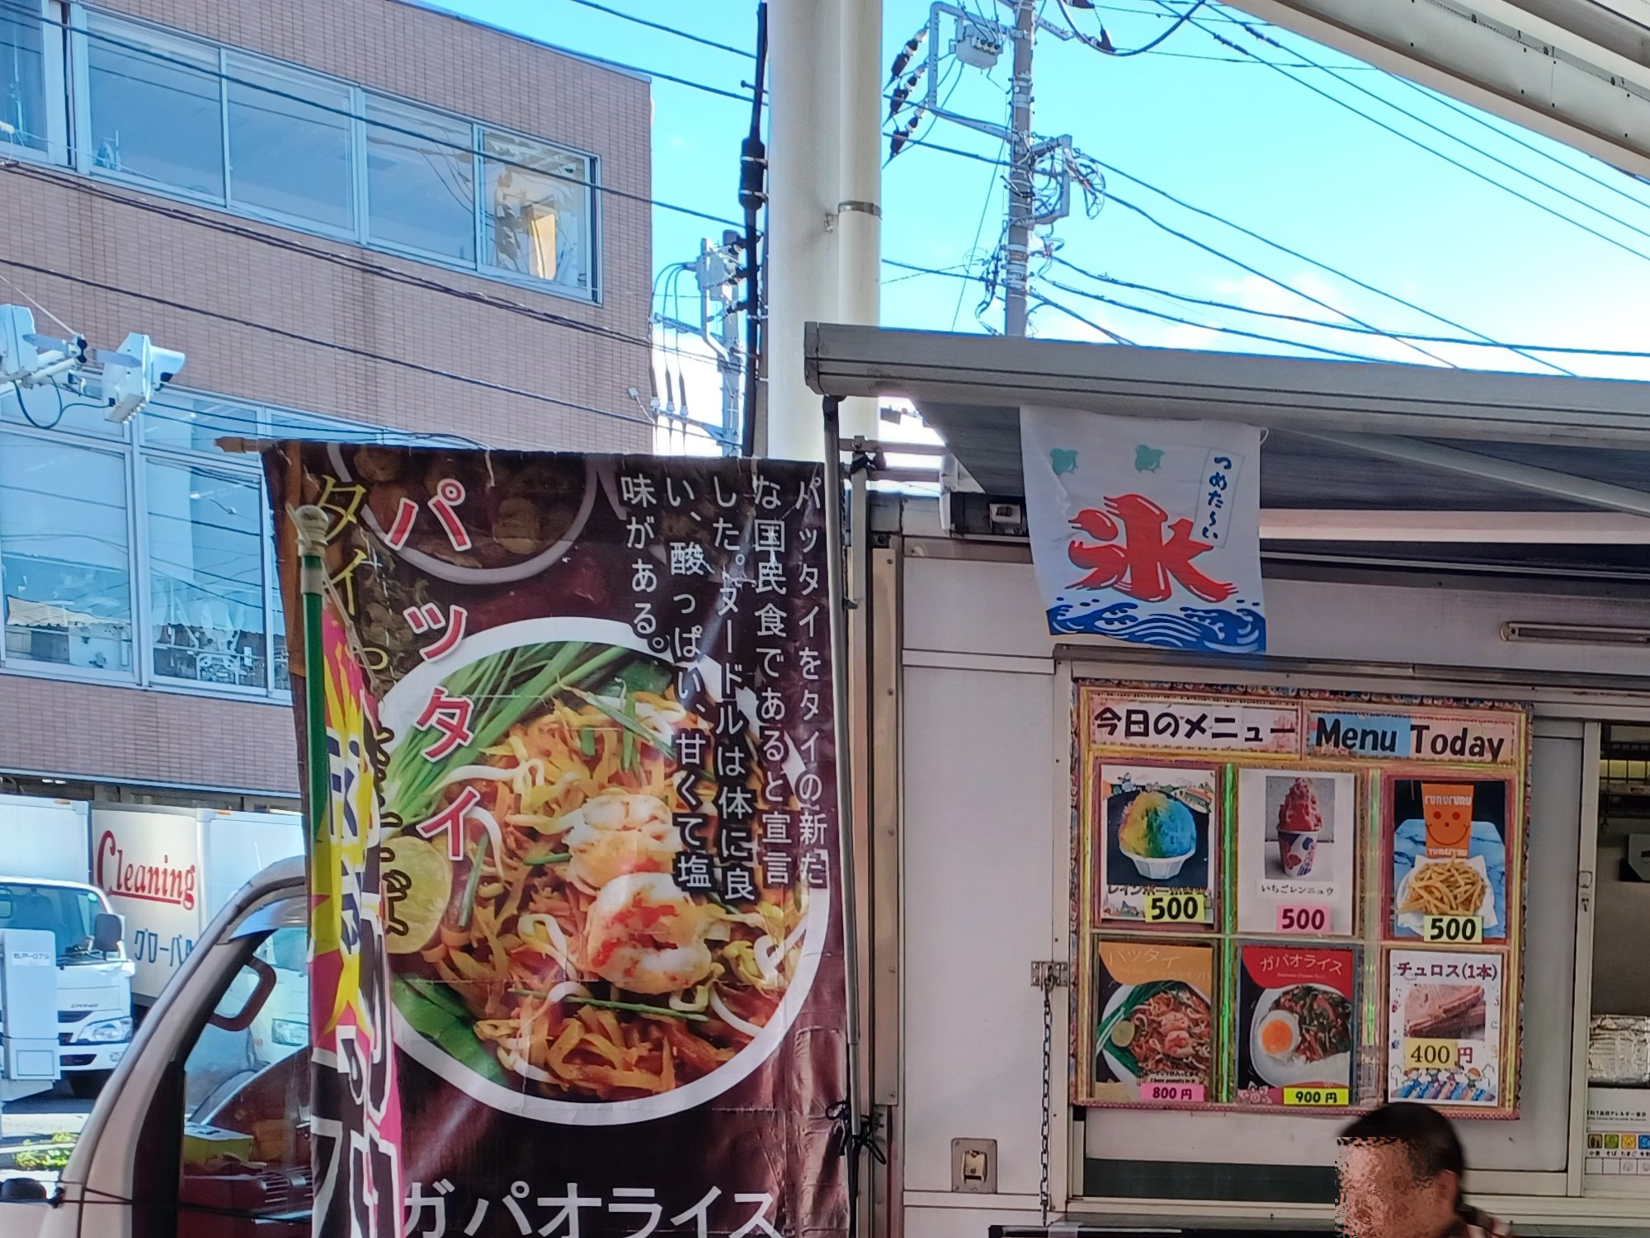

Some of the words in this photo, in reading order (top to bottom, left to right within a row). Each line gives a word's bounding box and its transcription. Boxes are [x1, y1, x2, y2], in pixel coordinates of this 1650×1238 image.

[621, 475, 665, 653] 味がある。
[1064, 493, 1239, 603] 氷
[385, 477, 479, 861] パッタイ
[666, 477, 712, 889] い、酸っぱい、甘くて塩
[712, 476, 755, 901] した。ヌードルは体に良
[754, 477, 791, 885] な国民食であると宣言
[796, 476, 828, 885] パッタイをタイの新た
[1094, 706, 1296, 744] 今日のメニュー
[1315, 716, 1396, 753] Menu
[1410, 723, 1505, 762] Today
[97, 830, 197, 910] Cleaning
[1151, 897, 1198, 921] 500
[1281, 908, 1326, 931] 500
[1430, 918, 1477, 942] 500
[1261, 951, 1343, 976] ガパオライス
[1397, 962, 1498, 981] チュロス(1本)
